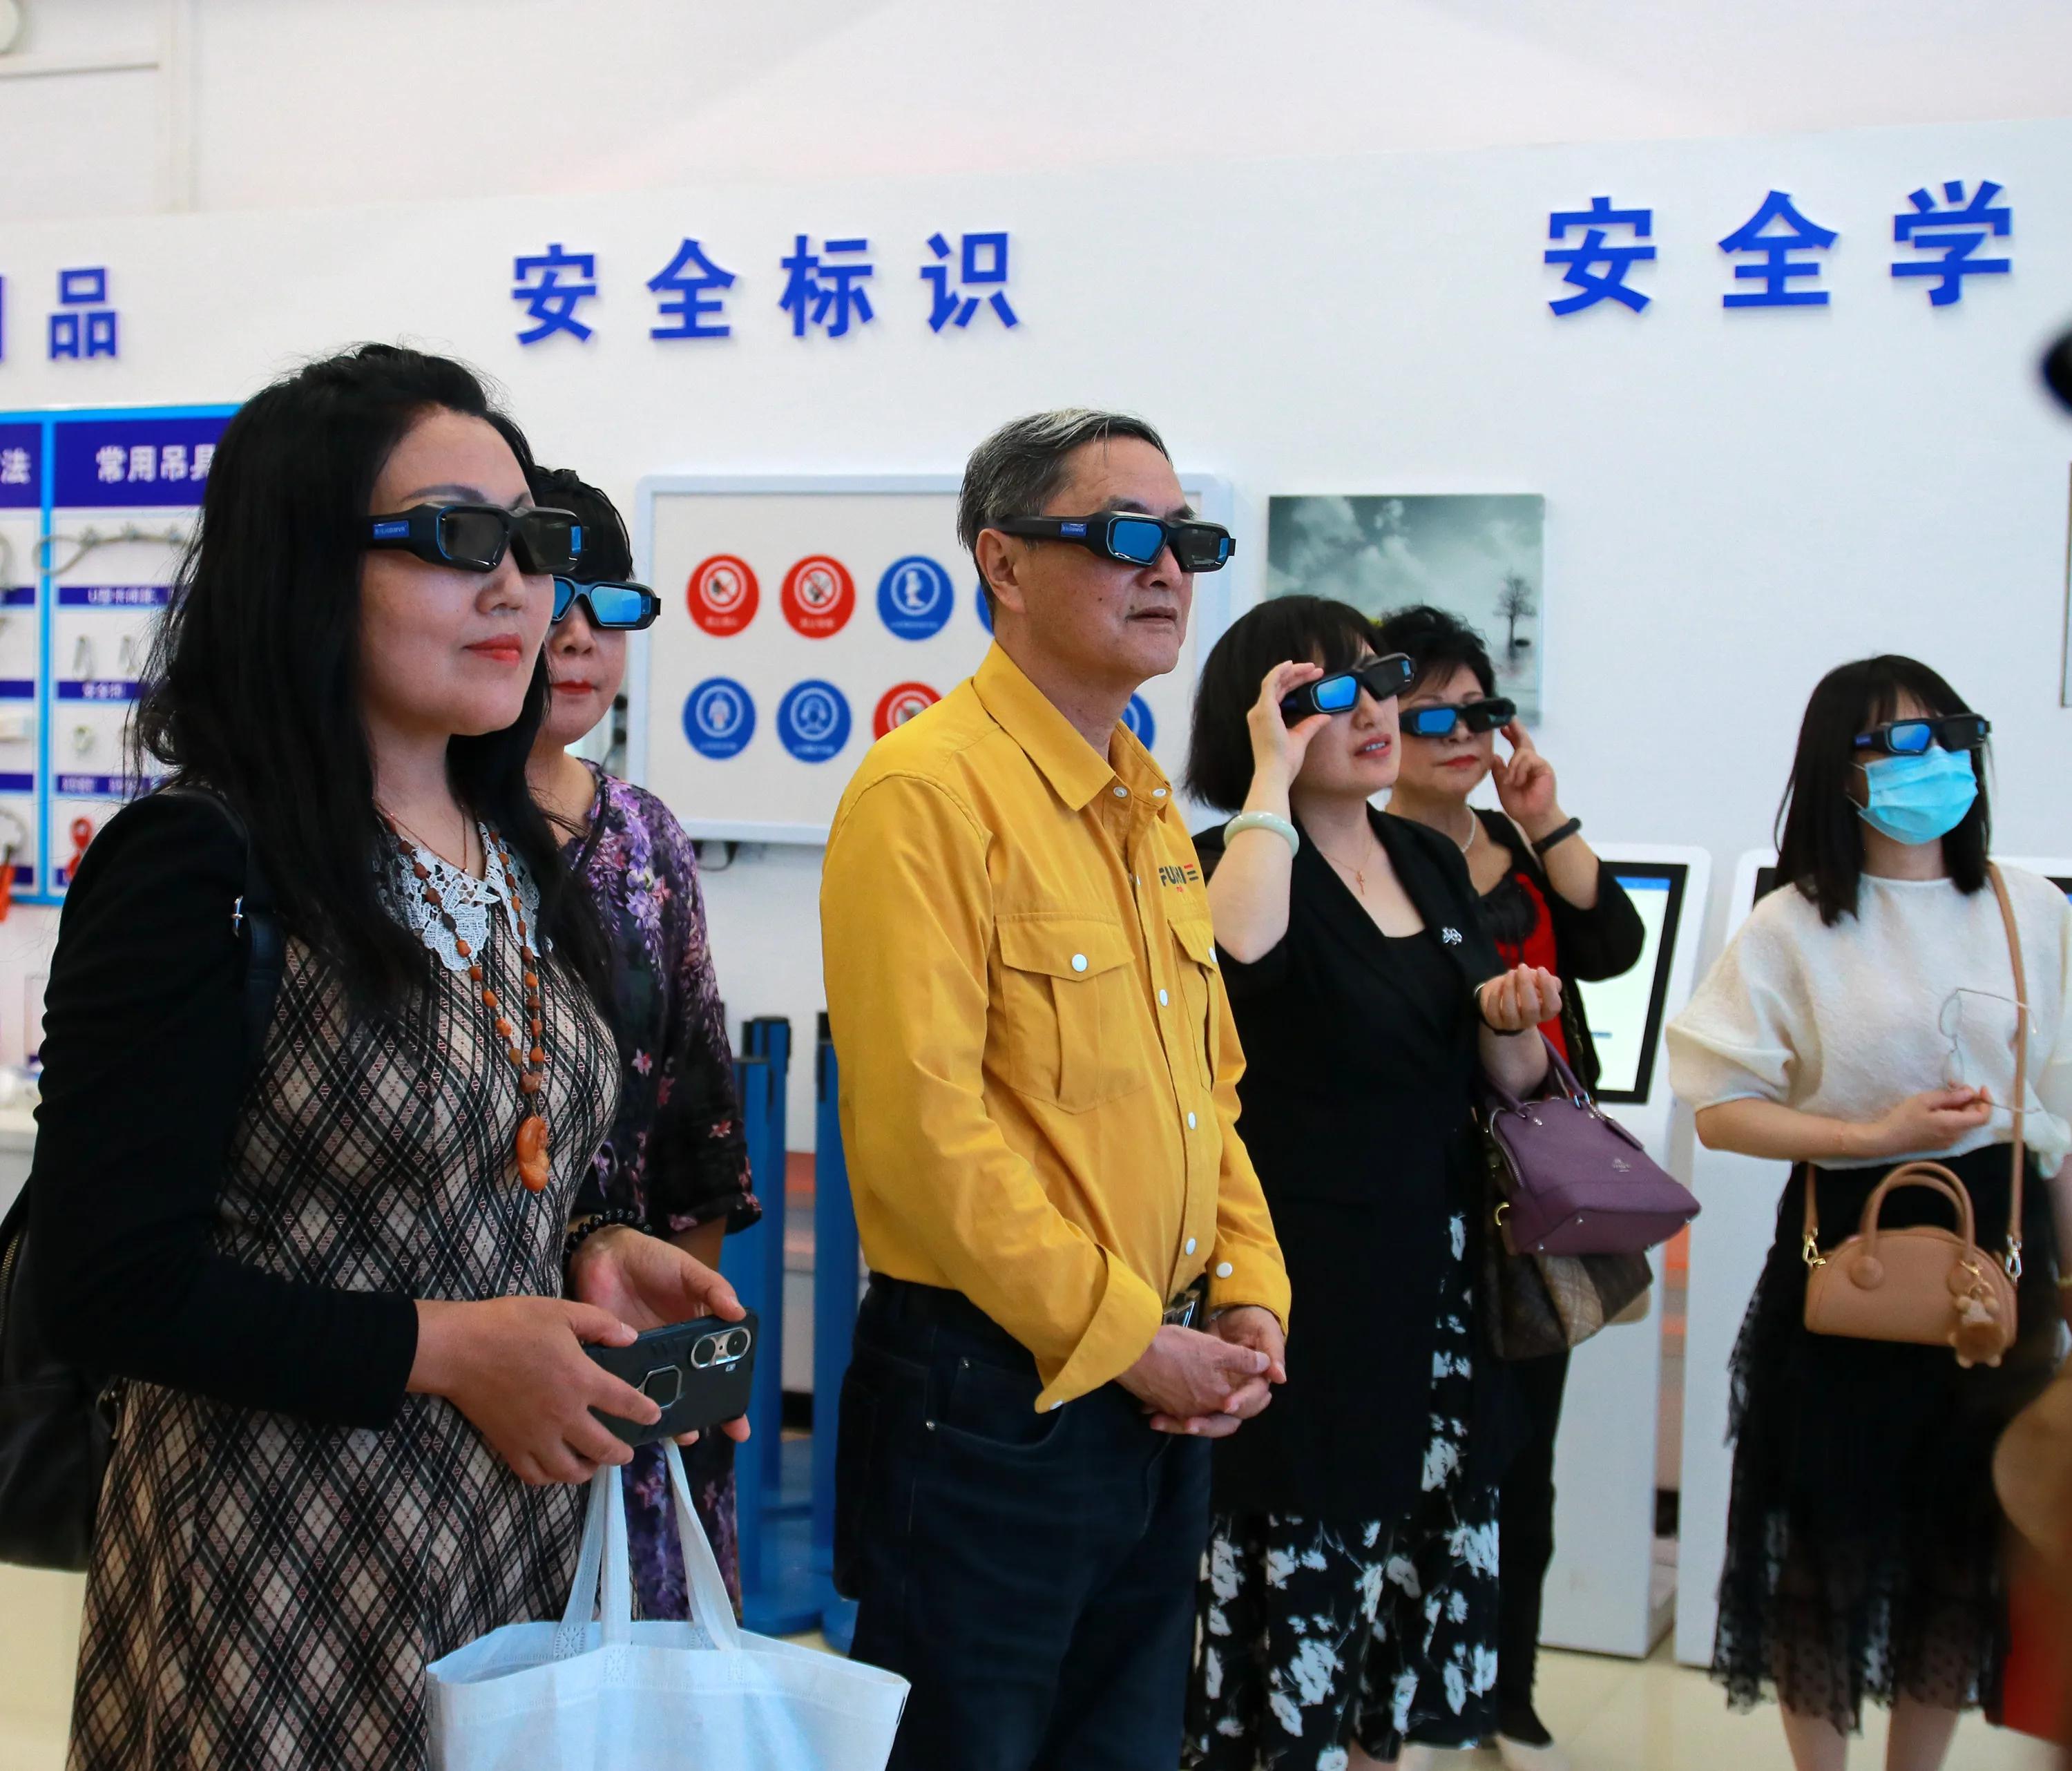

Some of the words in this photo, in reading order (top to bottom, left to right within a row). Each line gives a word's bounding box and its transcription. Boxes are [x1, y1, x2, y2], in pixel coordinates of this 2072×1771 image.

[511, 231, 1019, 345] 安全标识
[1544, 180, 2013, 317] 安全学
